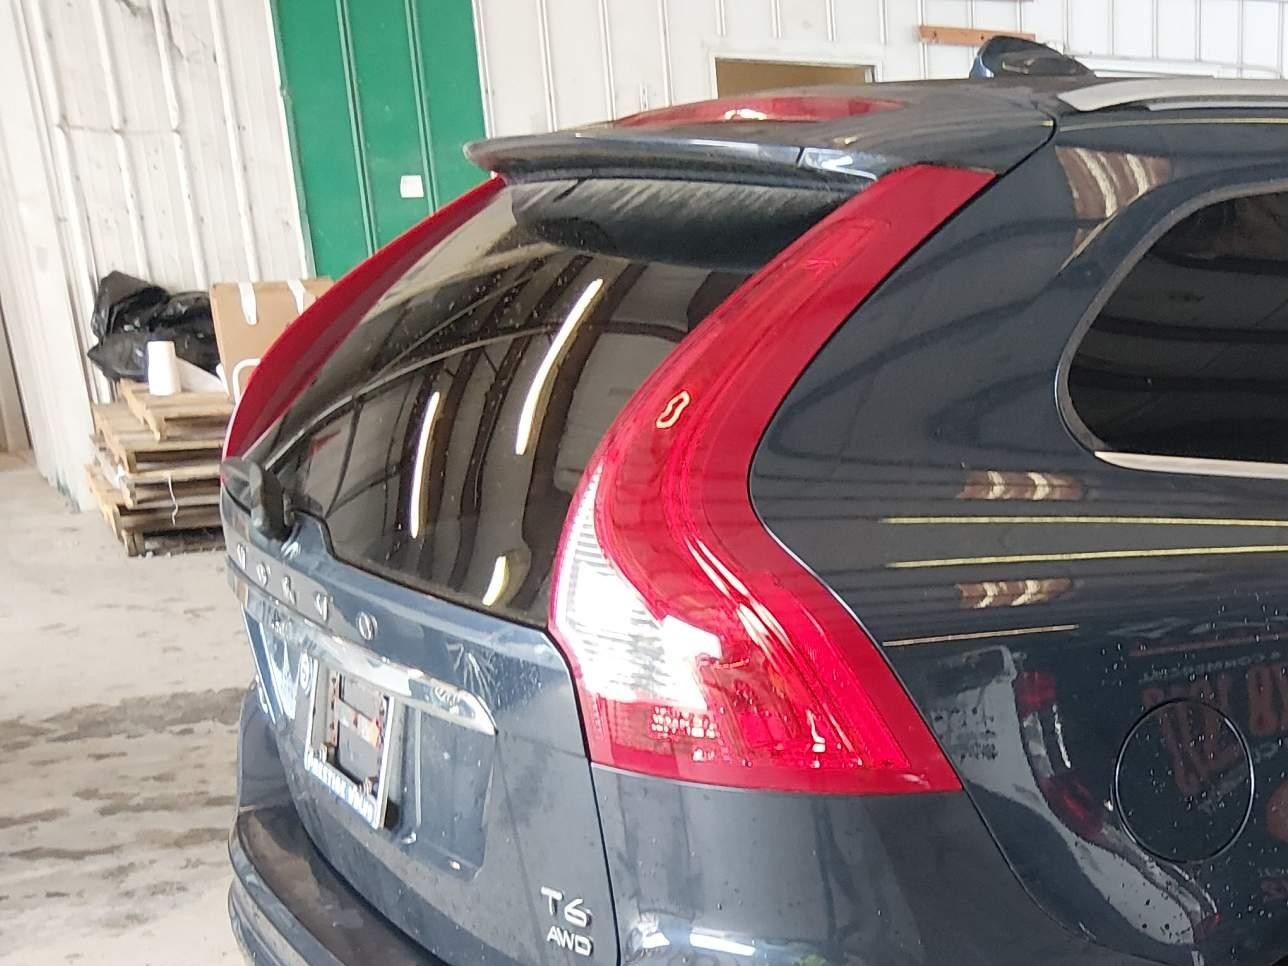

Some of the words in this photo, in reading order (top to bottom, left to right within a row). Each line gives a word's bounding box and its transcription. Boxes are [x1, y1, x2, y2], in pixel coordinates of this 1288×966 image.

[236, 543, 375, 641] VOLVO
[540, 886, 589, 928] T6
[546, 925, 592, 957] AWD
